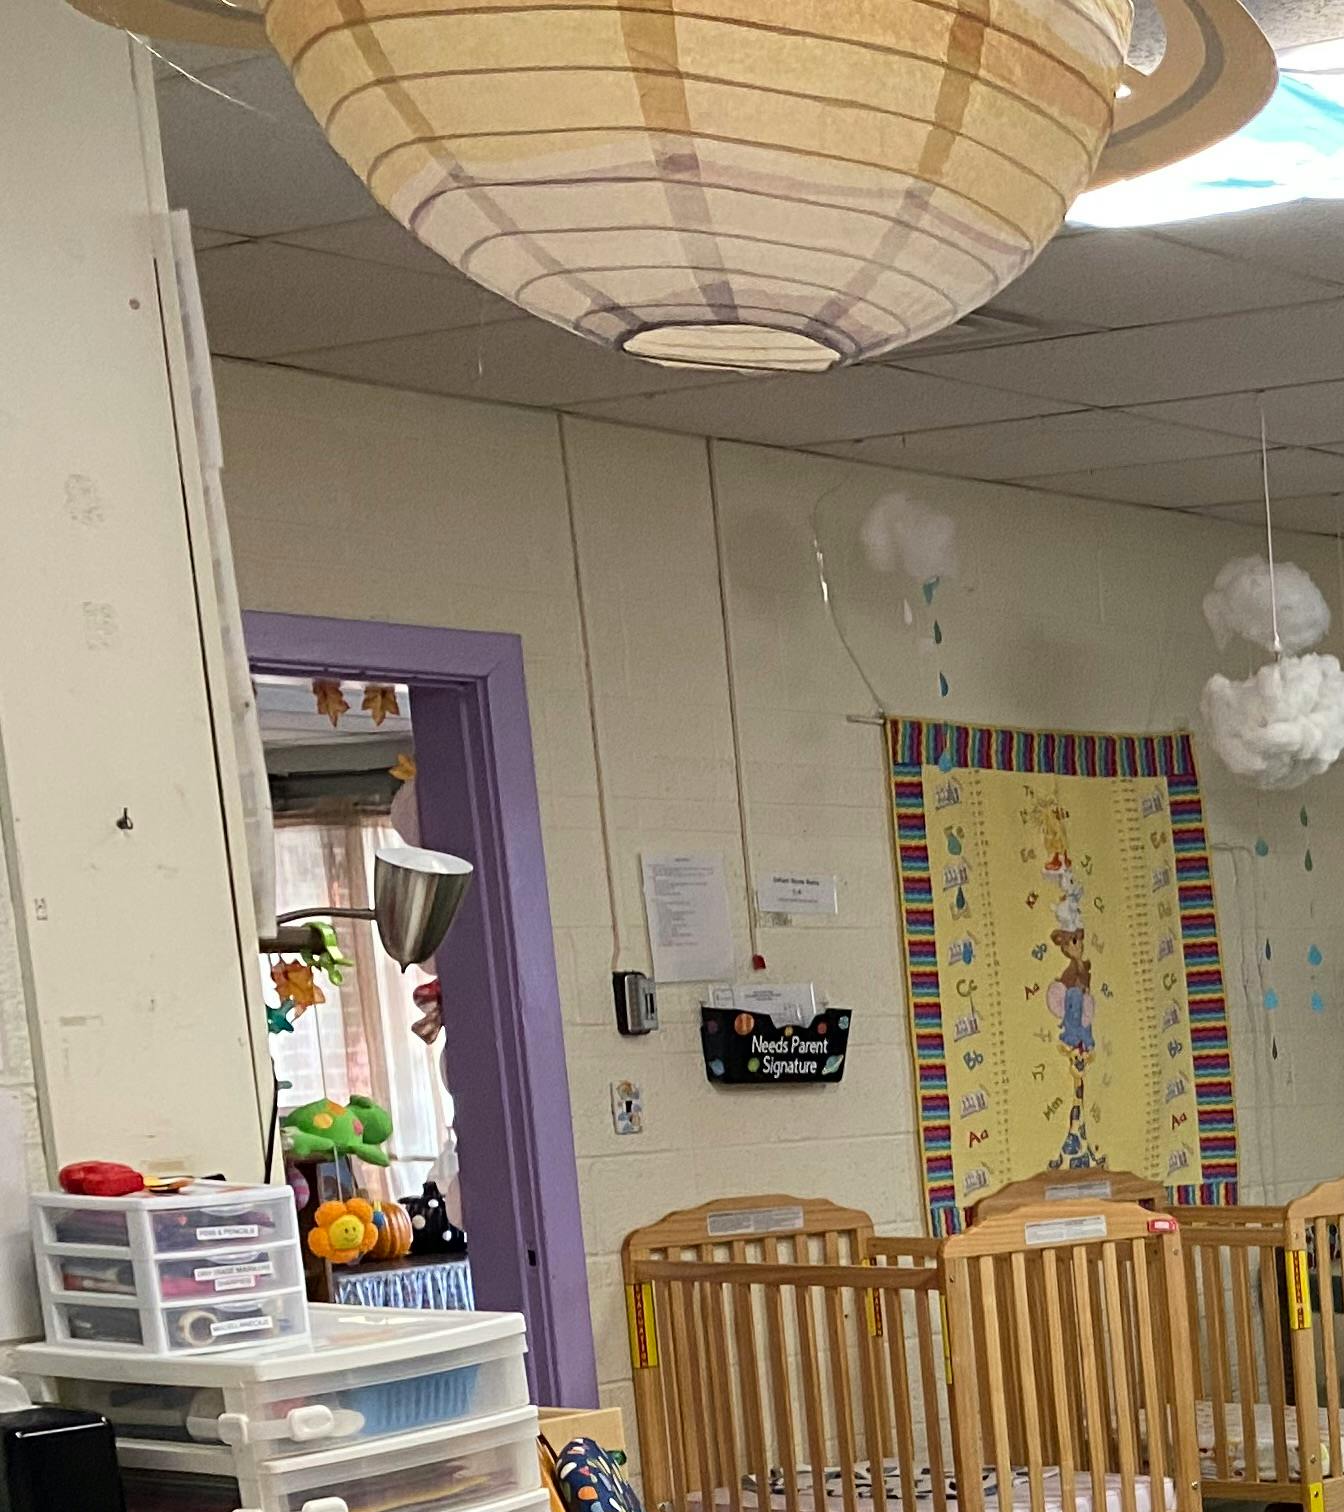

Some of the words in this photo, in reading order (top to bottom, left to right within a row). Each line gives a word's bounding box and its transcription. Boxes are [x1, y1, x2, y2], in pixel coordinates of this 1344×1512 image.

[752, 1036, 788, 1054] Needs
[791, 1036, 829, 1054] Parent
[762, 1056, 817, 1079] Signature
[1171, 1112, 1187, 1130] Aa
[968, 1128, 990, 1148] Aa
[224, 1227, 255, 1236] PENCILS
[236, 1264, 270, 1274] MARKERS
